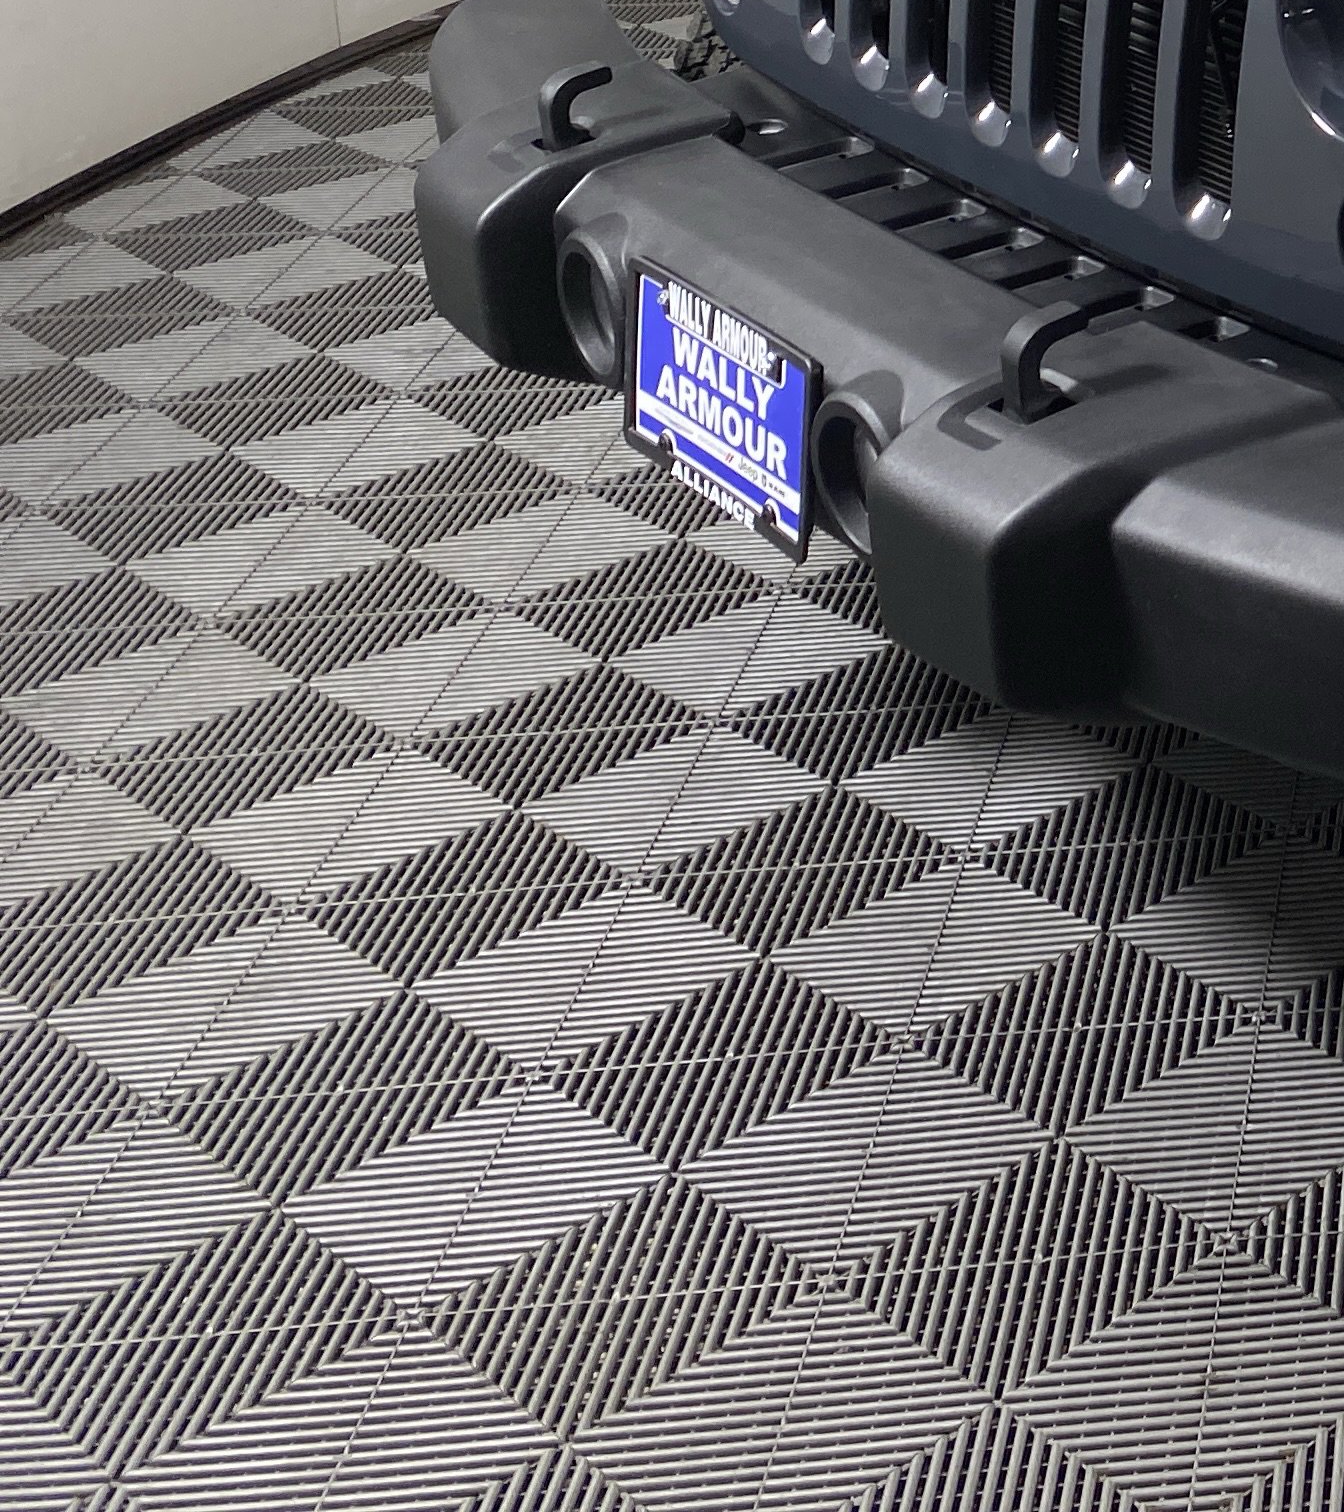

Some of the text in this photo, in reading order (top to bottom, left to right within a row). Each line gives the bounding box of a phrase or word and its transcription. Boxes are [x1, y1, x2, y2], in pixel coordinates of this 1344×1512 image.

[668, 281, 768, 376] WALLY ARMOUR
[672, 326, 775, 420] WALLY
[656, 364, 788, 481] ARMOUR
[671, 460, 755, 531] ALLIANCE
